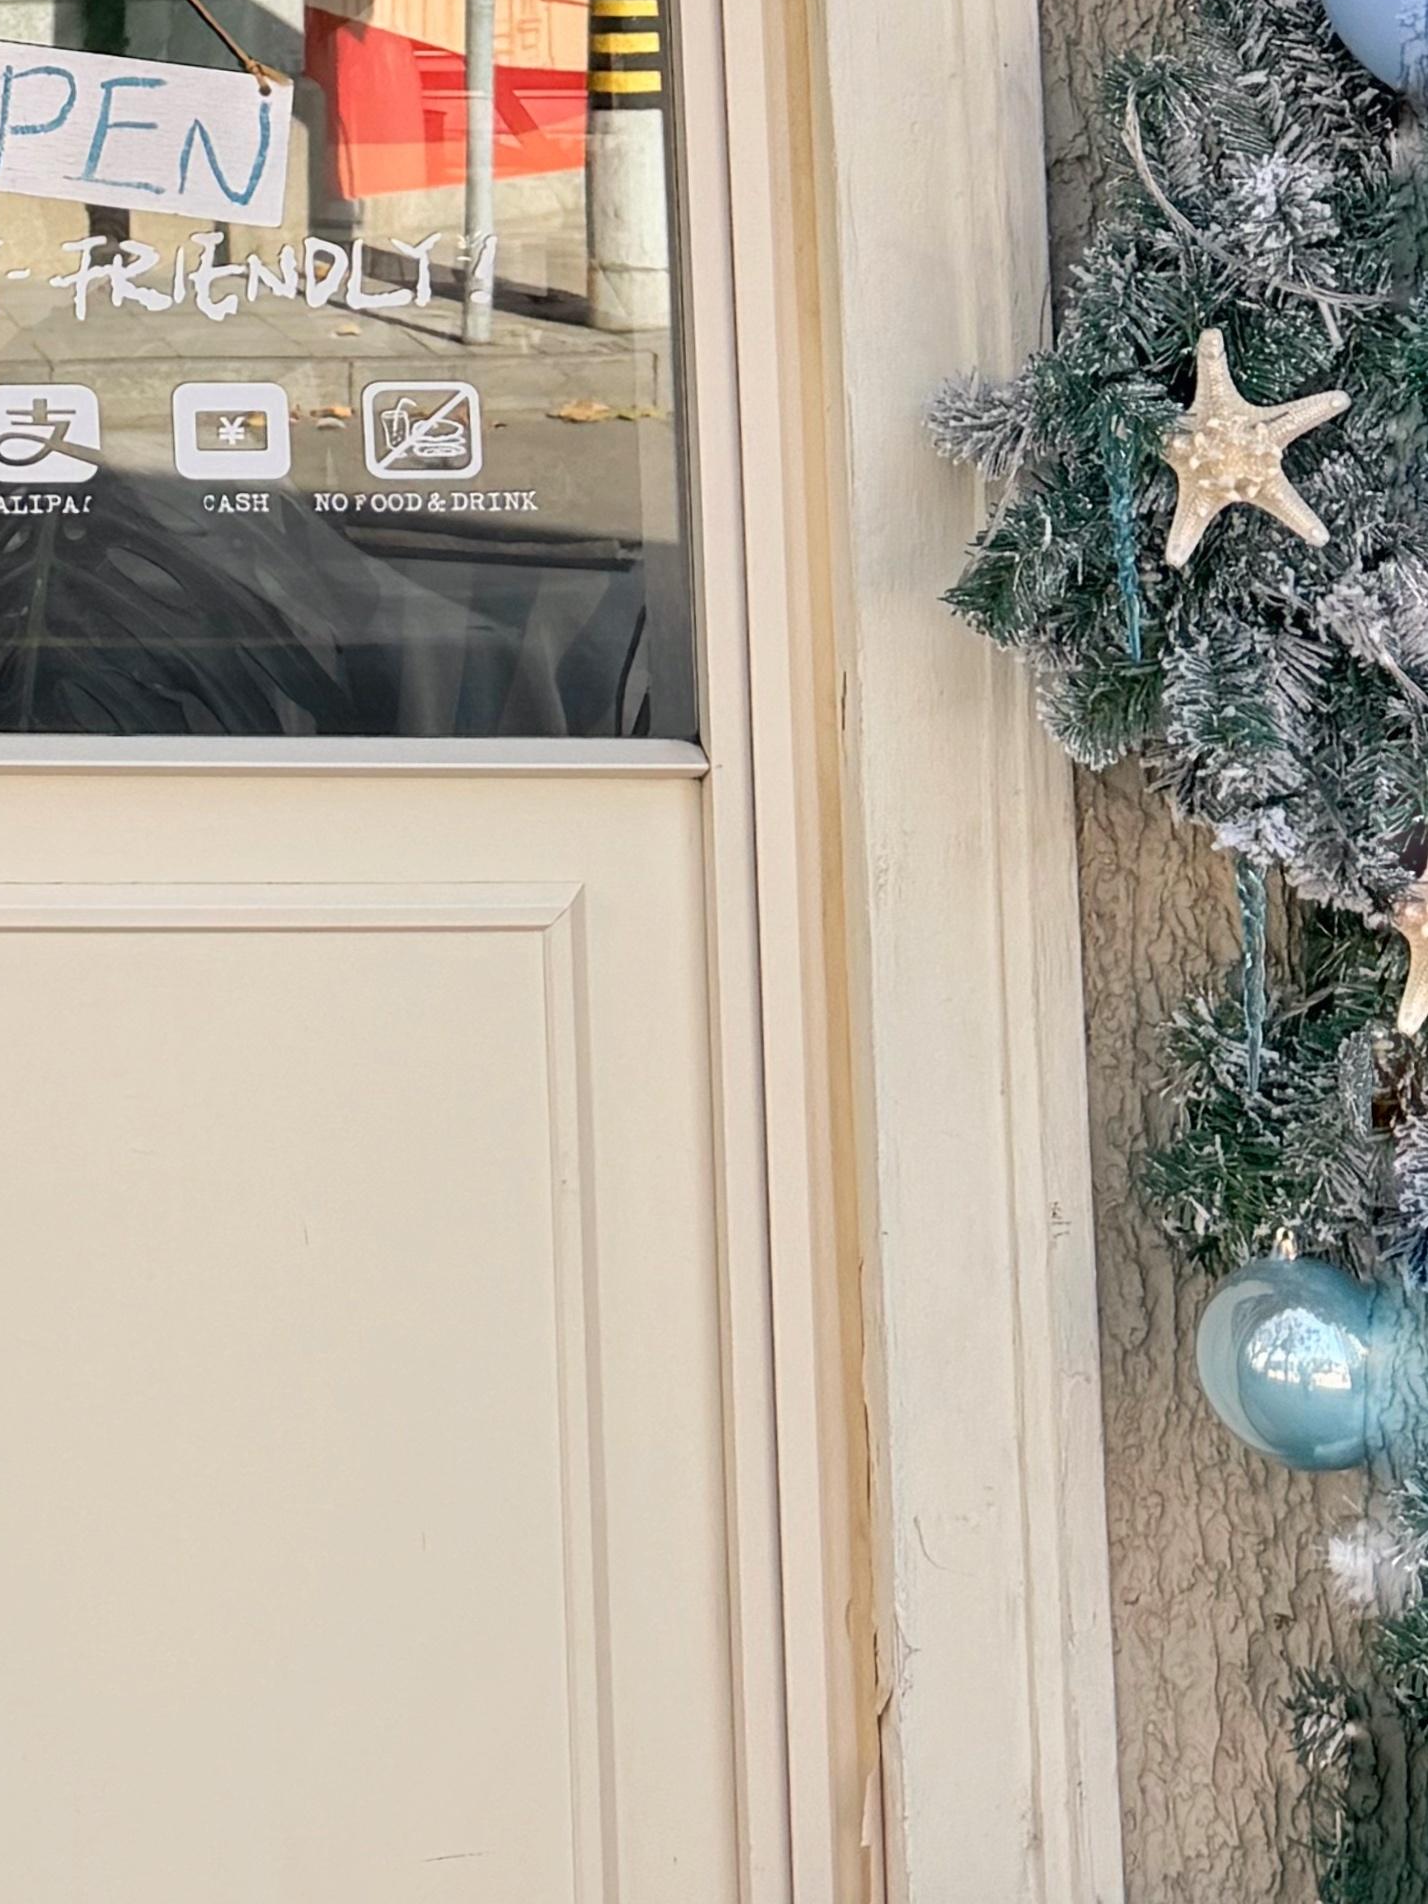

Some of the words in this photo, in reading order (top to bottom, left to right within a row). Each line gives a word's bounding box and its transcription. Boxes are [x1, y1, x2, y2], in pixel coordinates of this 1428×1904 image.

[203, 494, 270, 513] CASH
[314, 493, 348, 513] NO
[355, 492, 423, 512] FOOD
[427, 493, 446, 513] &
[450, 491, 538, 512] DRINK
